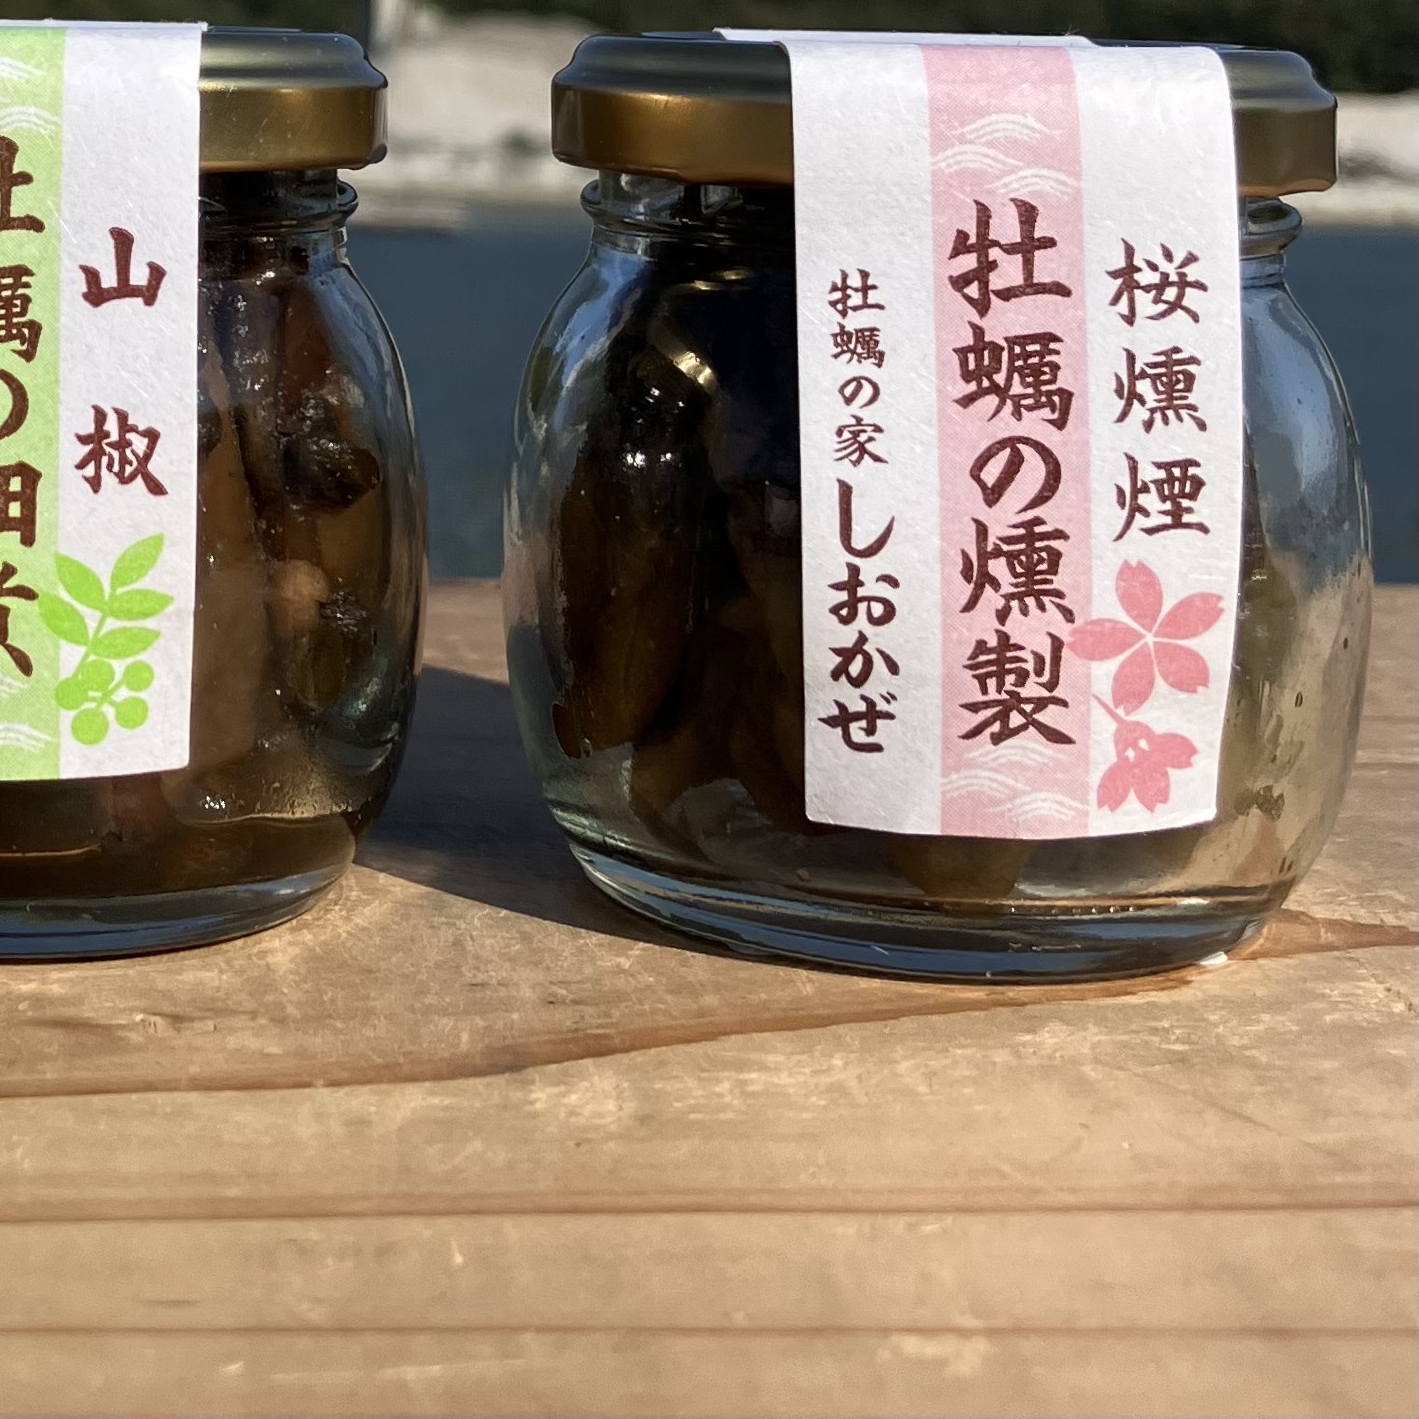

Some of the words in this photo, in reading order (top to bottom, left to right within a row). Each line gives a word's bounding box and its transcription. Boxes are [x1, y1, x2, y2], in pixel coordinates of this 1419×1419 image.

[75, 227, 167, 495] 山椒
[948, 198, 1075, 745] 牡蠣の燻製
[1107, 239, 1209, 541] 桜燻煙
